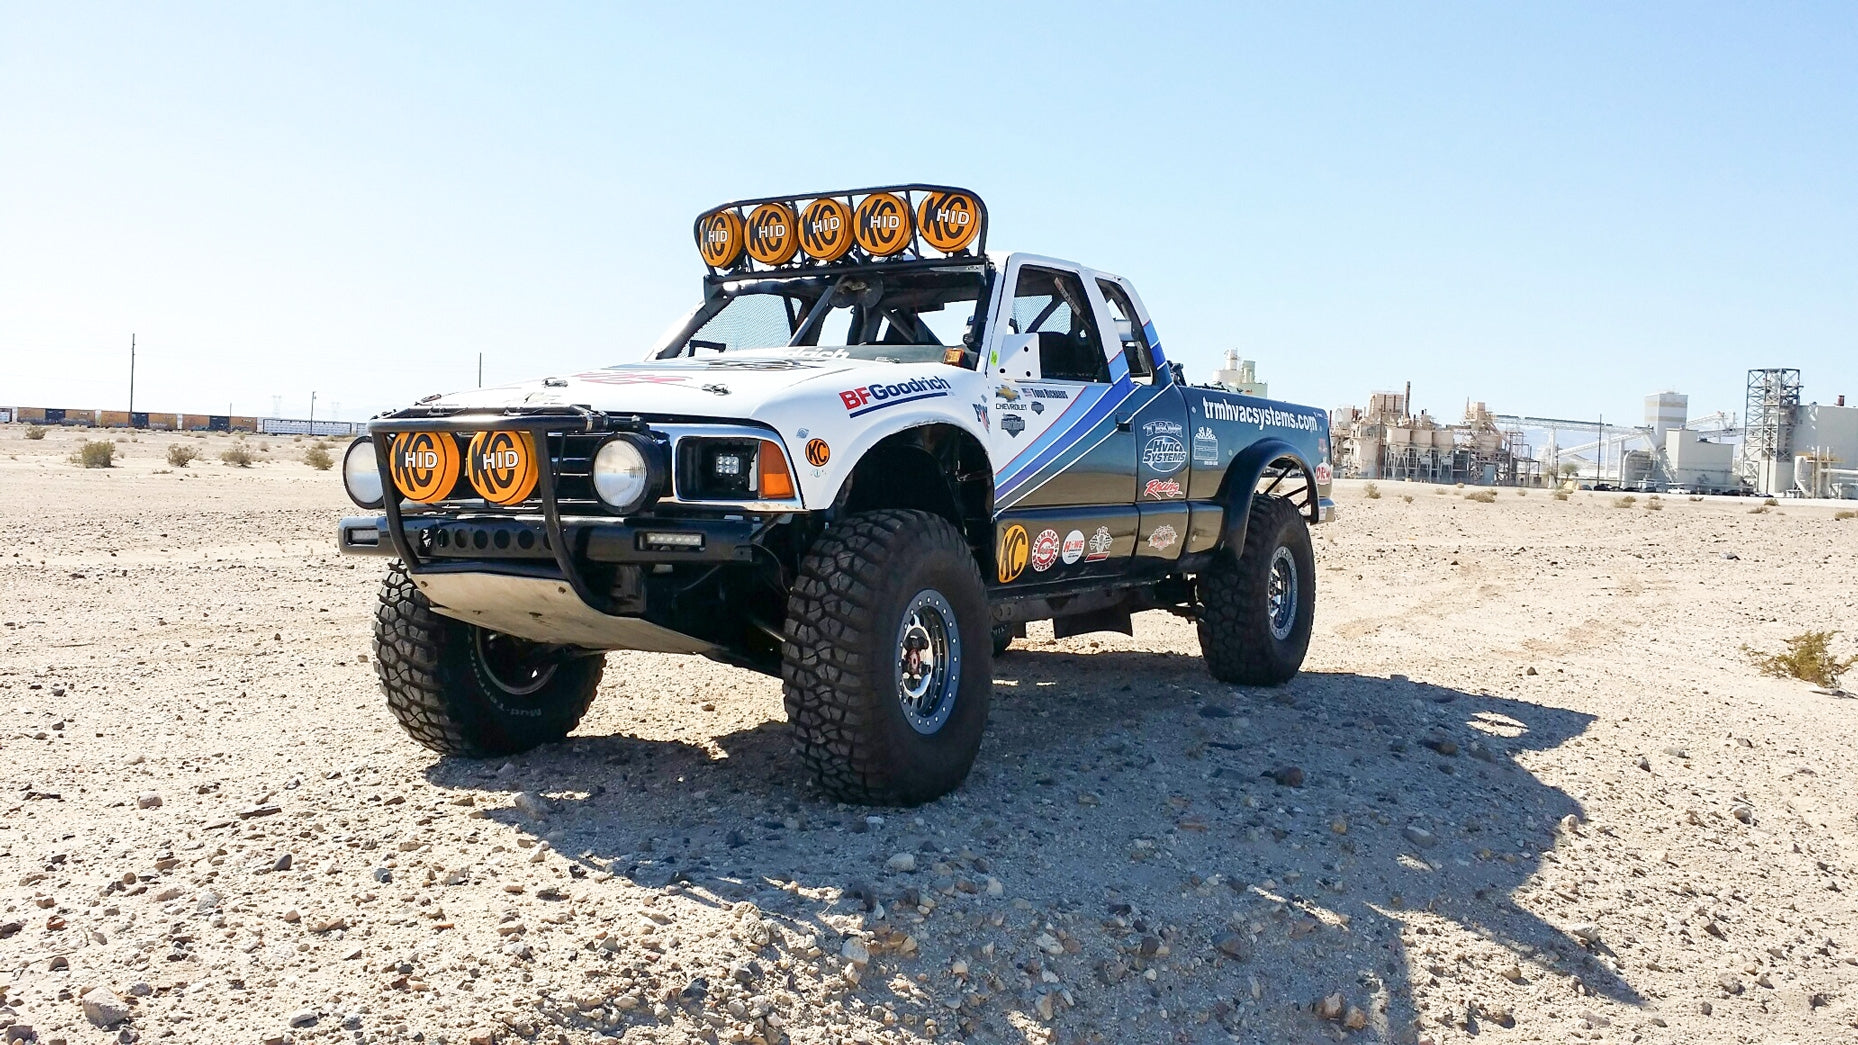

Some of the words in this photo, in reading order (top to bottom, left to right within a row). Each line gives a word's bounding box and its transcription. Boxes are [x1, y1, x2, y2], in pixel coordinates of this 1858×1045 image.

[750, 209, 783, 256] KC
[758, 224, 785, 238] HID
[803, 203, 840, 251] KC
[812, 216, 840, 233] HID
[859, 198, 898, 248] KC
[870, 215, 900, 229] HID
[924, 193, 967, 241] KC
[937, 208, 970, 225] HID
[702, 215, 726, 260] KC
[708, 230, 728, 243] HID
[839, 376, 951, 410] BFGoodrich
[996, 403, 1027, 411] CHEVROLET
[1203, 396, 1318, 431] trmhvacsystems.com
[395, 432, 434, 492] KC
[405, 451, 438, 469] HID
[472, 431, 515, 494] KC
[482, 451, 519, 470] HID
[808, 440, 828, 465] KC
[1001, 528, 1026, 580] KC
